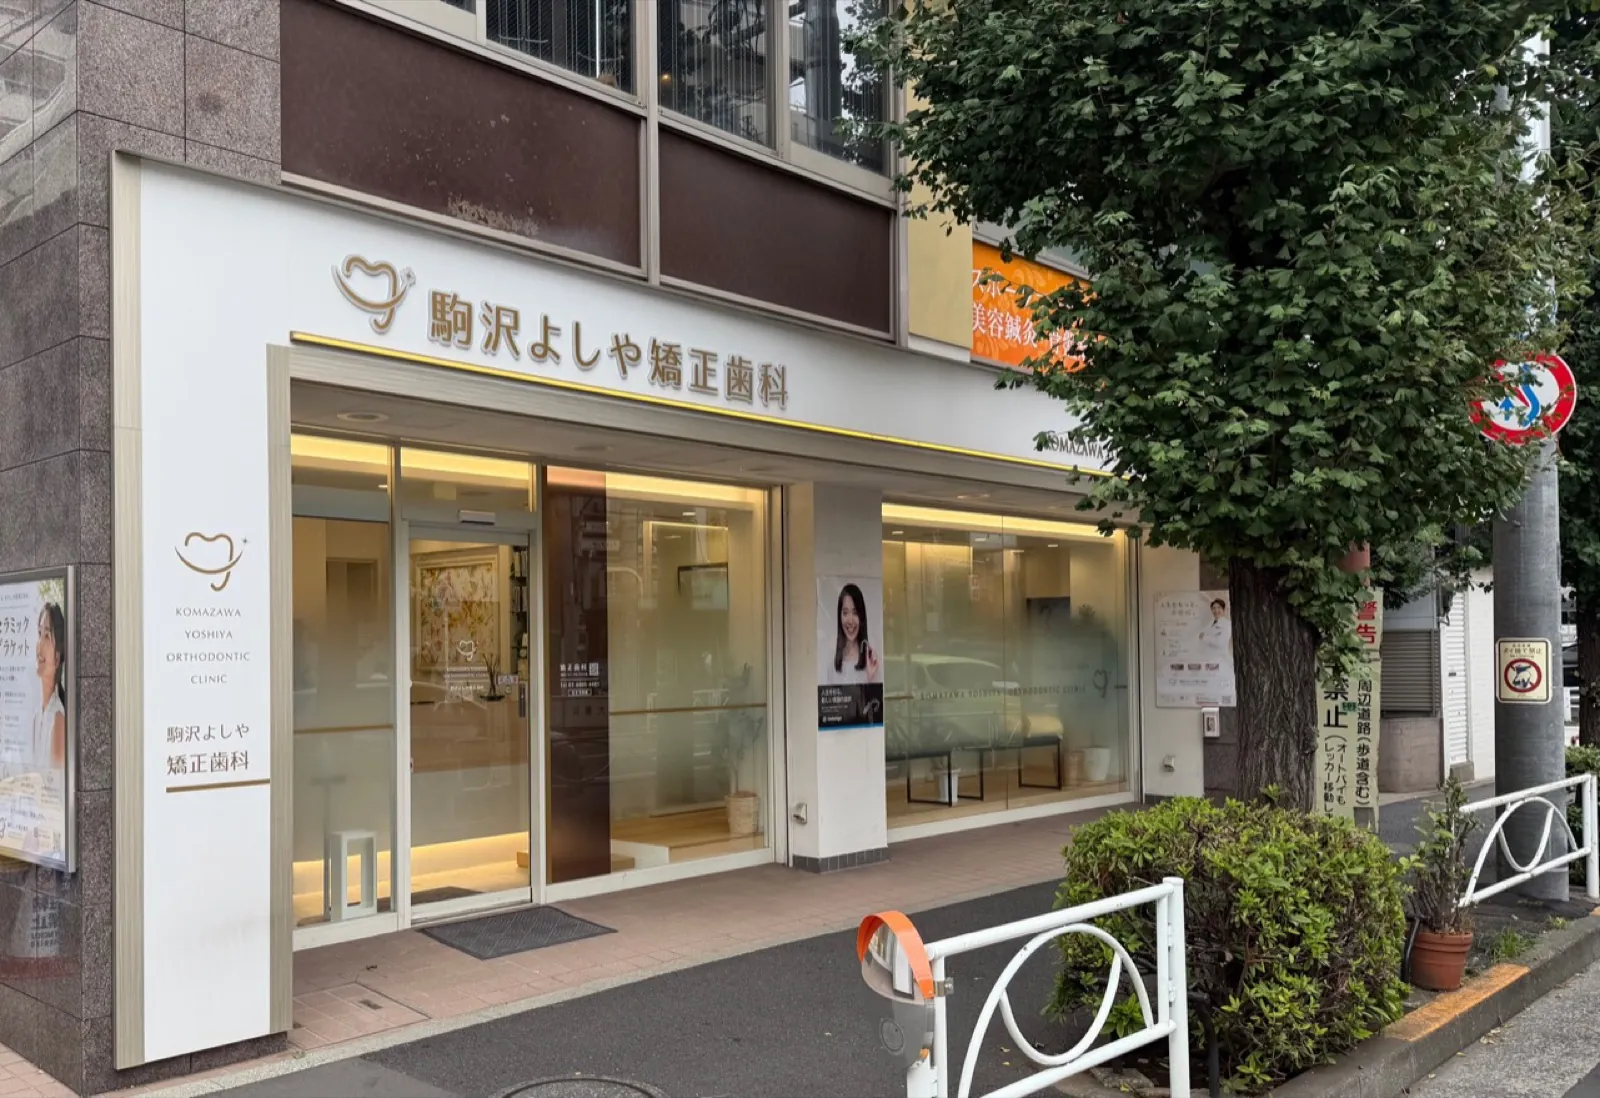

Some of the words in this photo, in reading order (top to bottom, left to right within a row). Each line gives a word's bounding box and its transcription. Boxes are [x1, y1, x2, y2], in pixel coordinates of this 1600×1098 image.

[972, 303, 1037, 348] 美容鍼灸
[428, 289, 787, 406] 駒沢よしや矯正歯科
[1047, 434, 1104, 460] OMAZAWA
[175, 607, 242, 617] KOMAZAWA
[0, 616, 30, 634] ラミック
[184, 629, 233, 640] YOSHIYA
[0, 638, 30, 657] ラケット
[166, 651, 251, 662] ORTHODONTIC
[190, 674, 227, 684] CLINIC
[166, 723, 250, 743] 駒沢よしや
[166, 750, 250, 776] 矯正歯科
